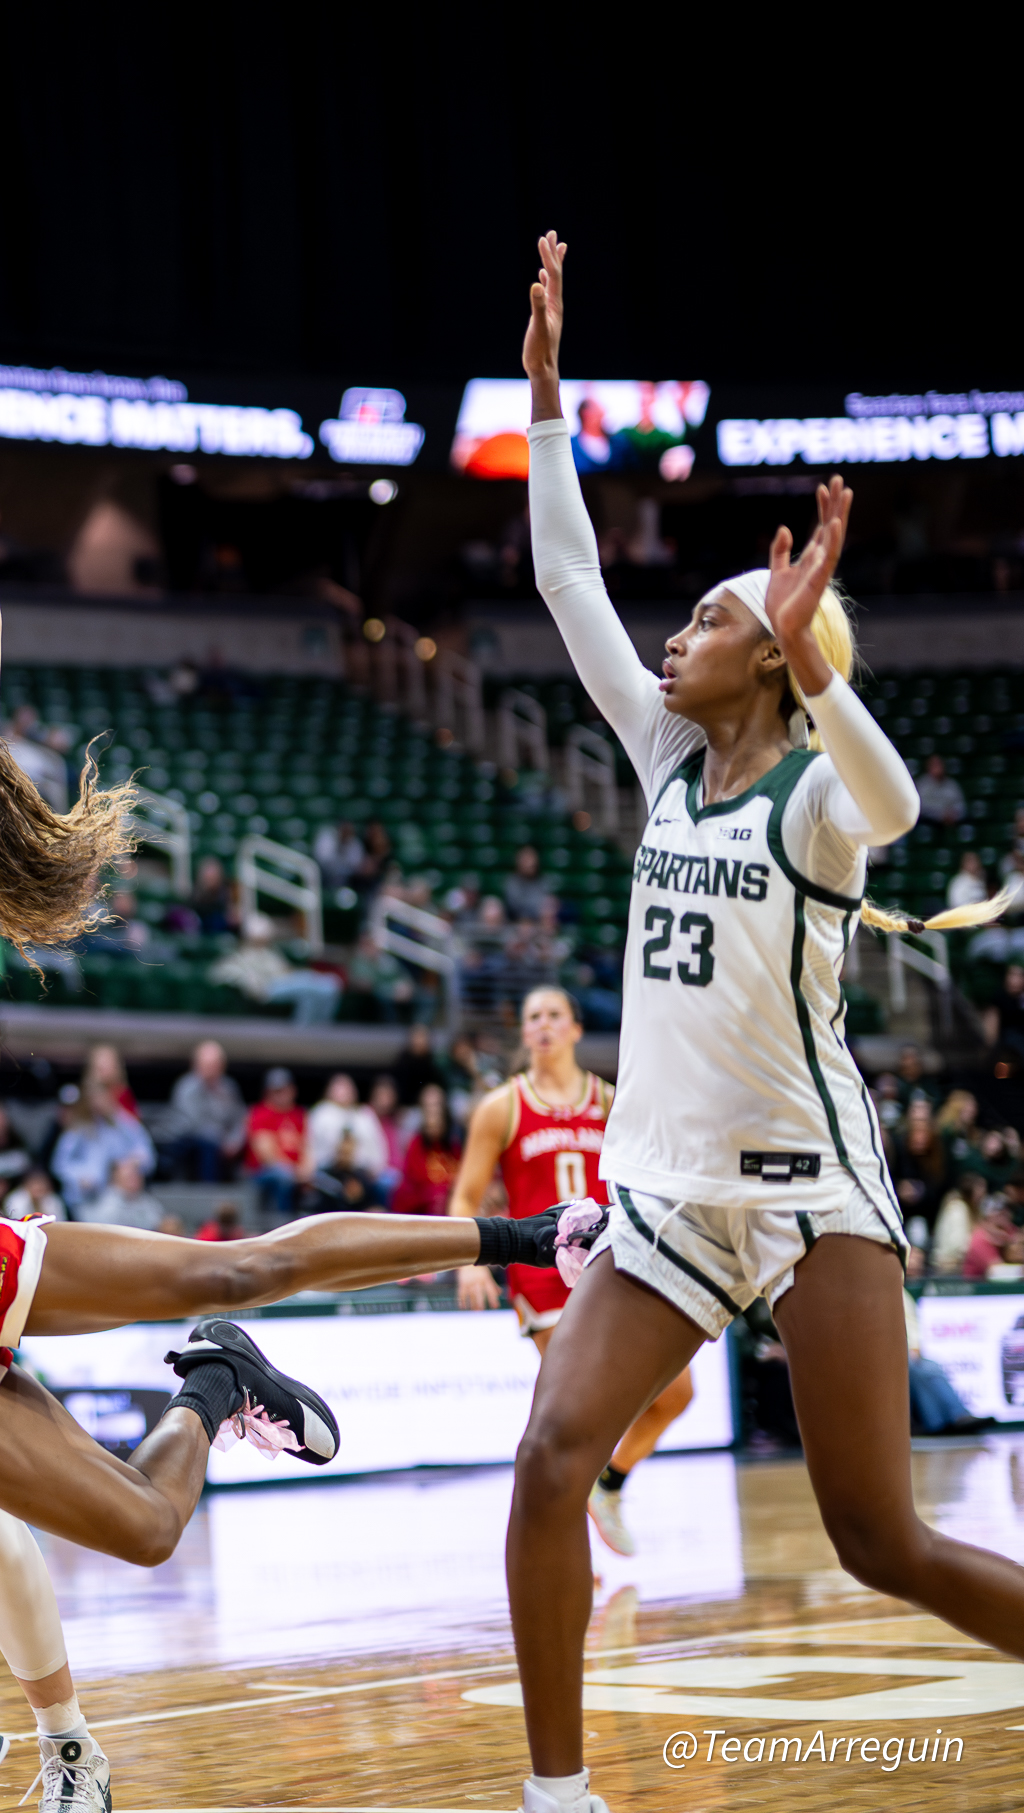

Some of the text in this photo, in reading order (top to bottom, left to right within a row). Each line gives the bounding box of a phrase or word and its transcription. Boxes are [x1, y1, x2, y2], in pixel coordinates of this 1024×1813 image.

[716, 414, 990, 466] EXPERIENCE
[643, 905, 715, 987] 23
[554, 1151, 588, 1203] 0
